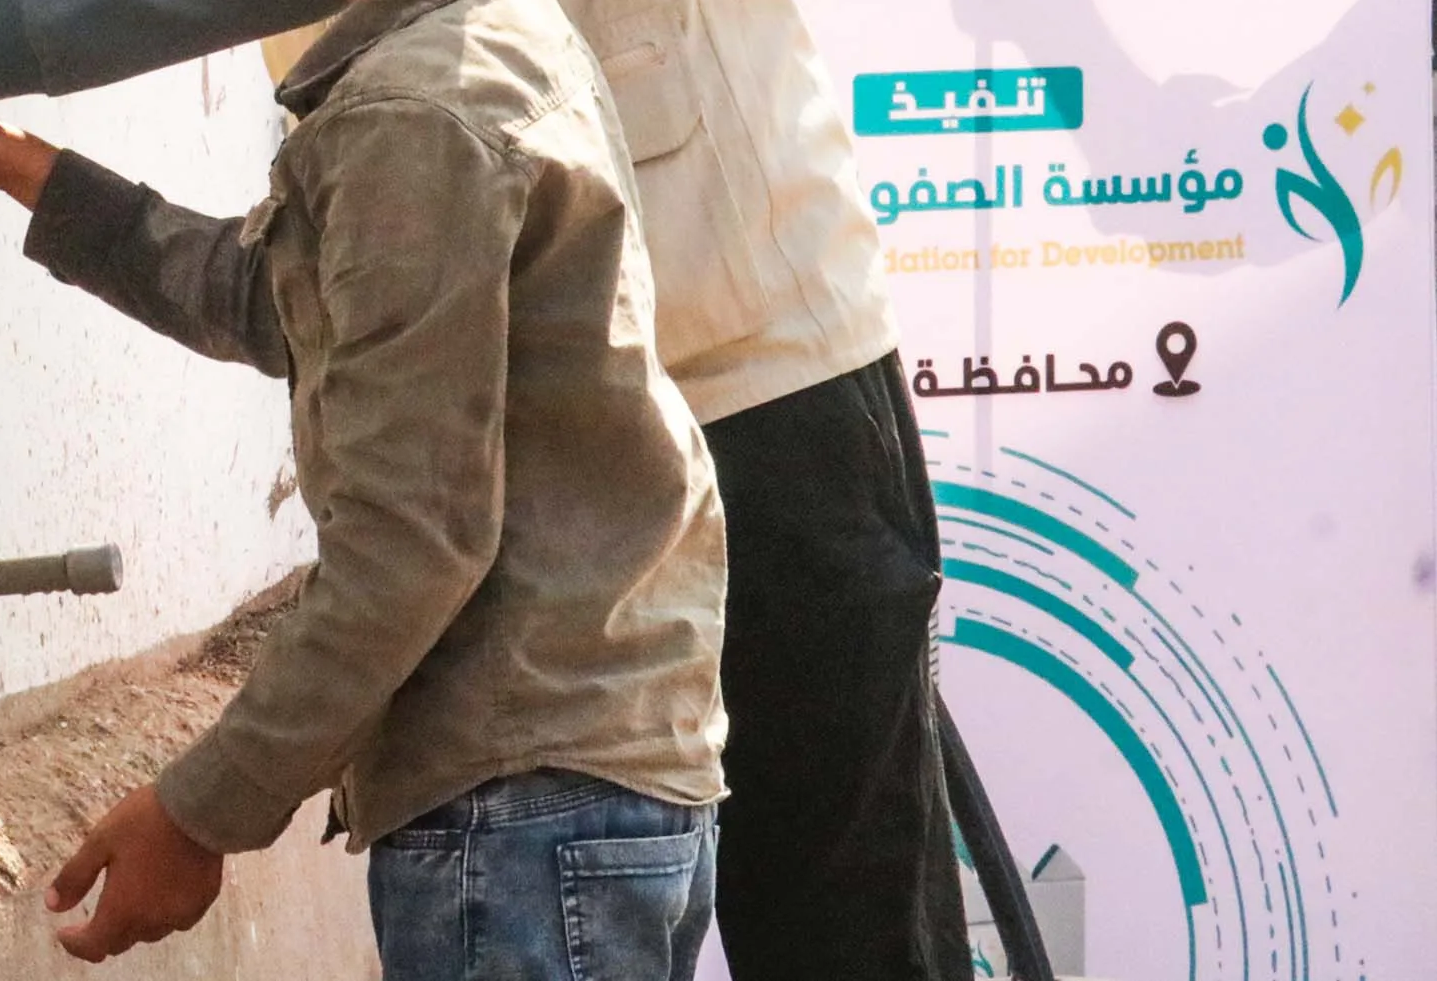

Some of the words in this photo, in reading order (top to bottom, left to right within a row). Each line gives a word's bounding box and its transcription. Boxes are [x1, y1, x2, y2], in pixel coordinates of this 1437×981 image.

[889, 68, 1046, 129] تنفيذ
[869, 163, 1023, 225] الصفو
[1043, 149, 1244, 213] مؤسسة
[884, 246, 980, 274] dation
[990, 241, 1032, 270] for
[1041, 232, 1245, 270] Development
[913, 354, 1133, 399] محافظة
